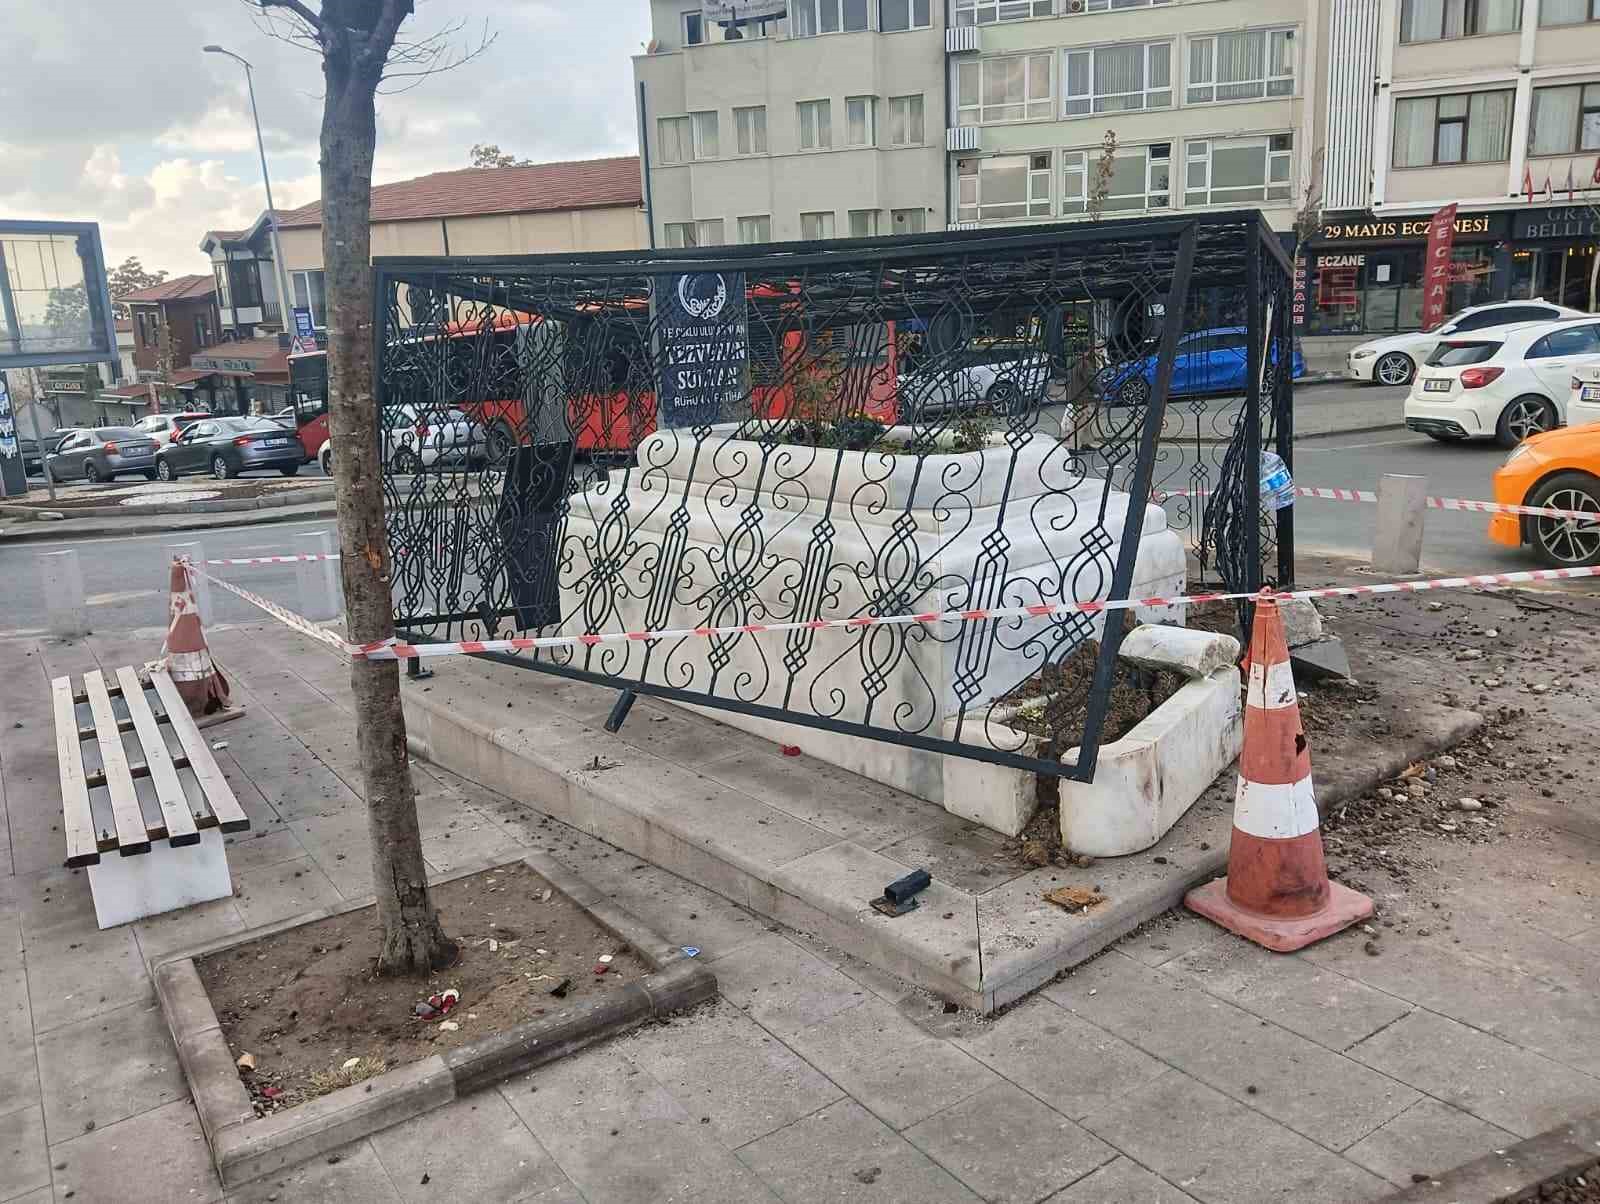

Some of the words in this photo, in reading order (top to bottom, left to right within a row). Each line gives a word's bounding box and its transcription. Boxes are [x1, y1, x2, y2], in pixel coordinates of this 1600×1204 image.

[1325, 225, 1342, 239] 29
[1344, 222, 1397, 238] MAYIS
[1401, 216, 1490, 235] ECZNESİ
[1317, 255, 1366, 267] ECZANE
